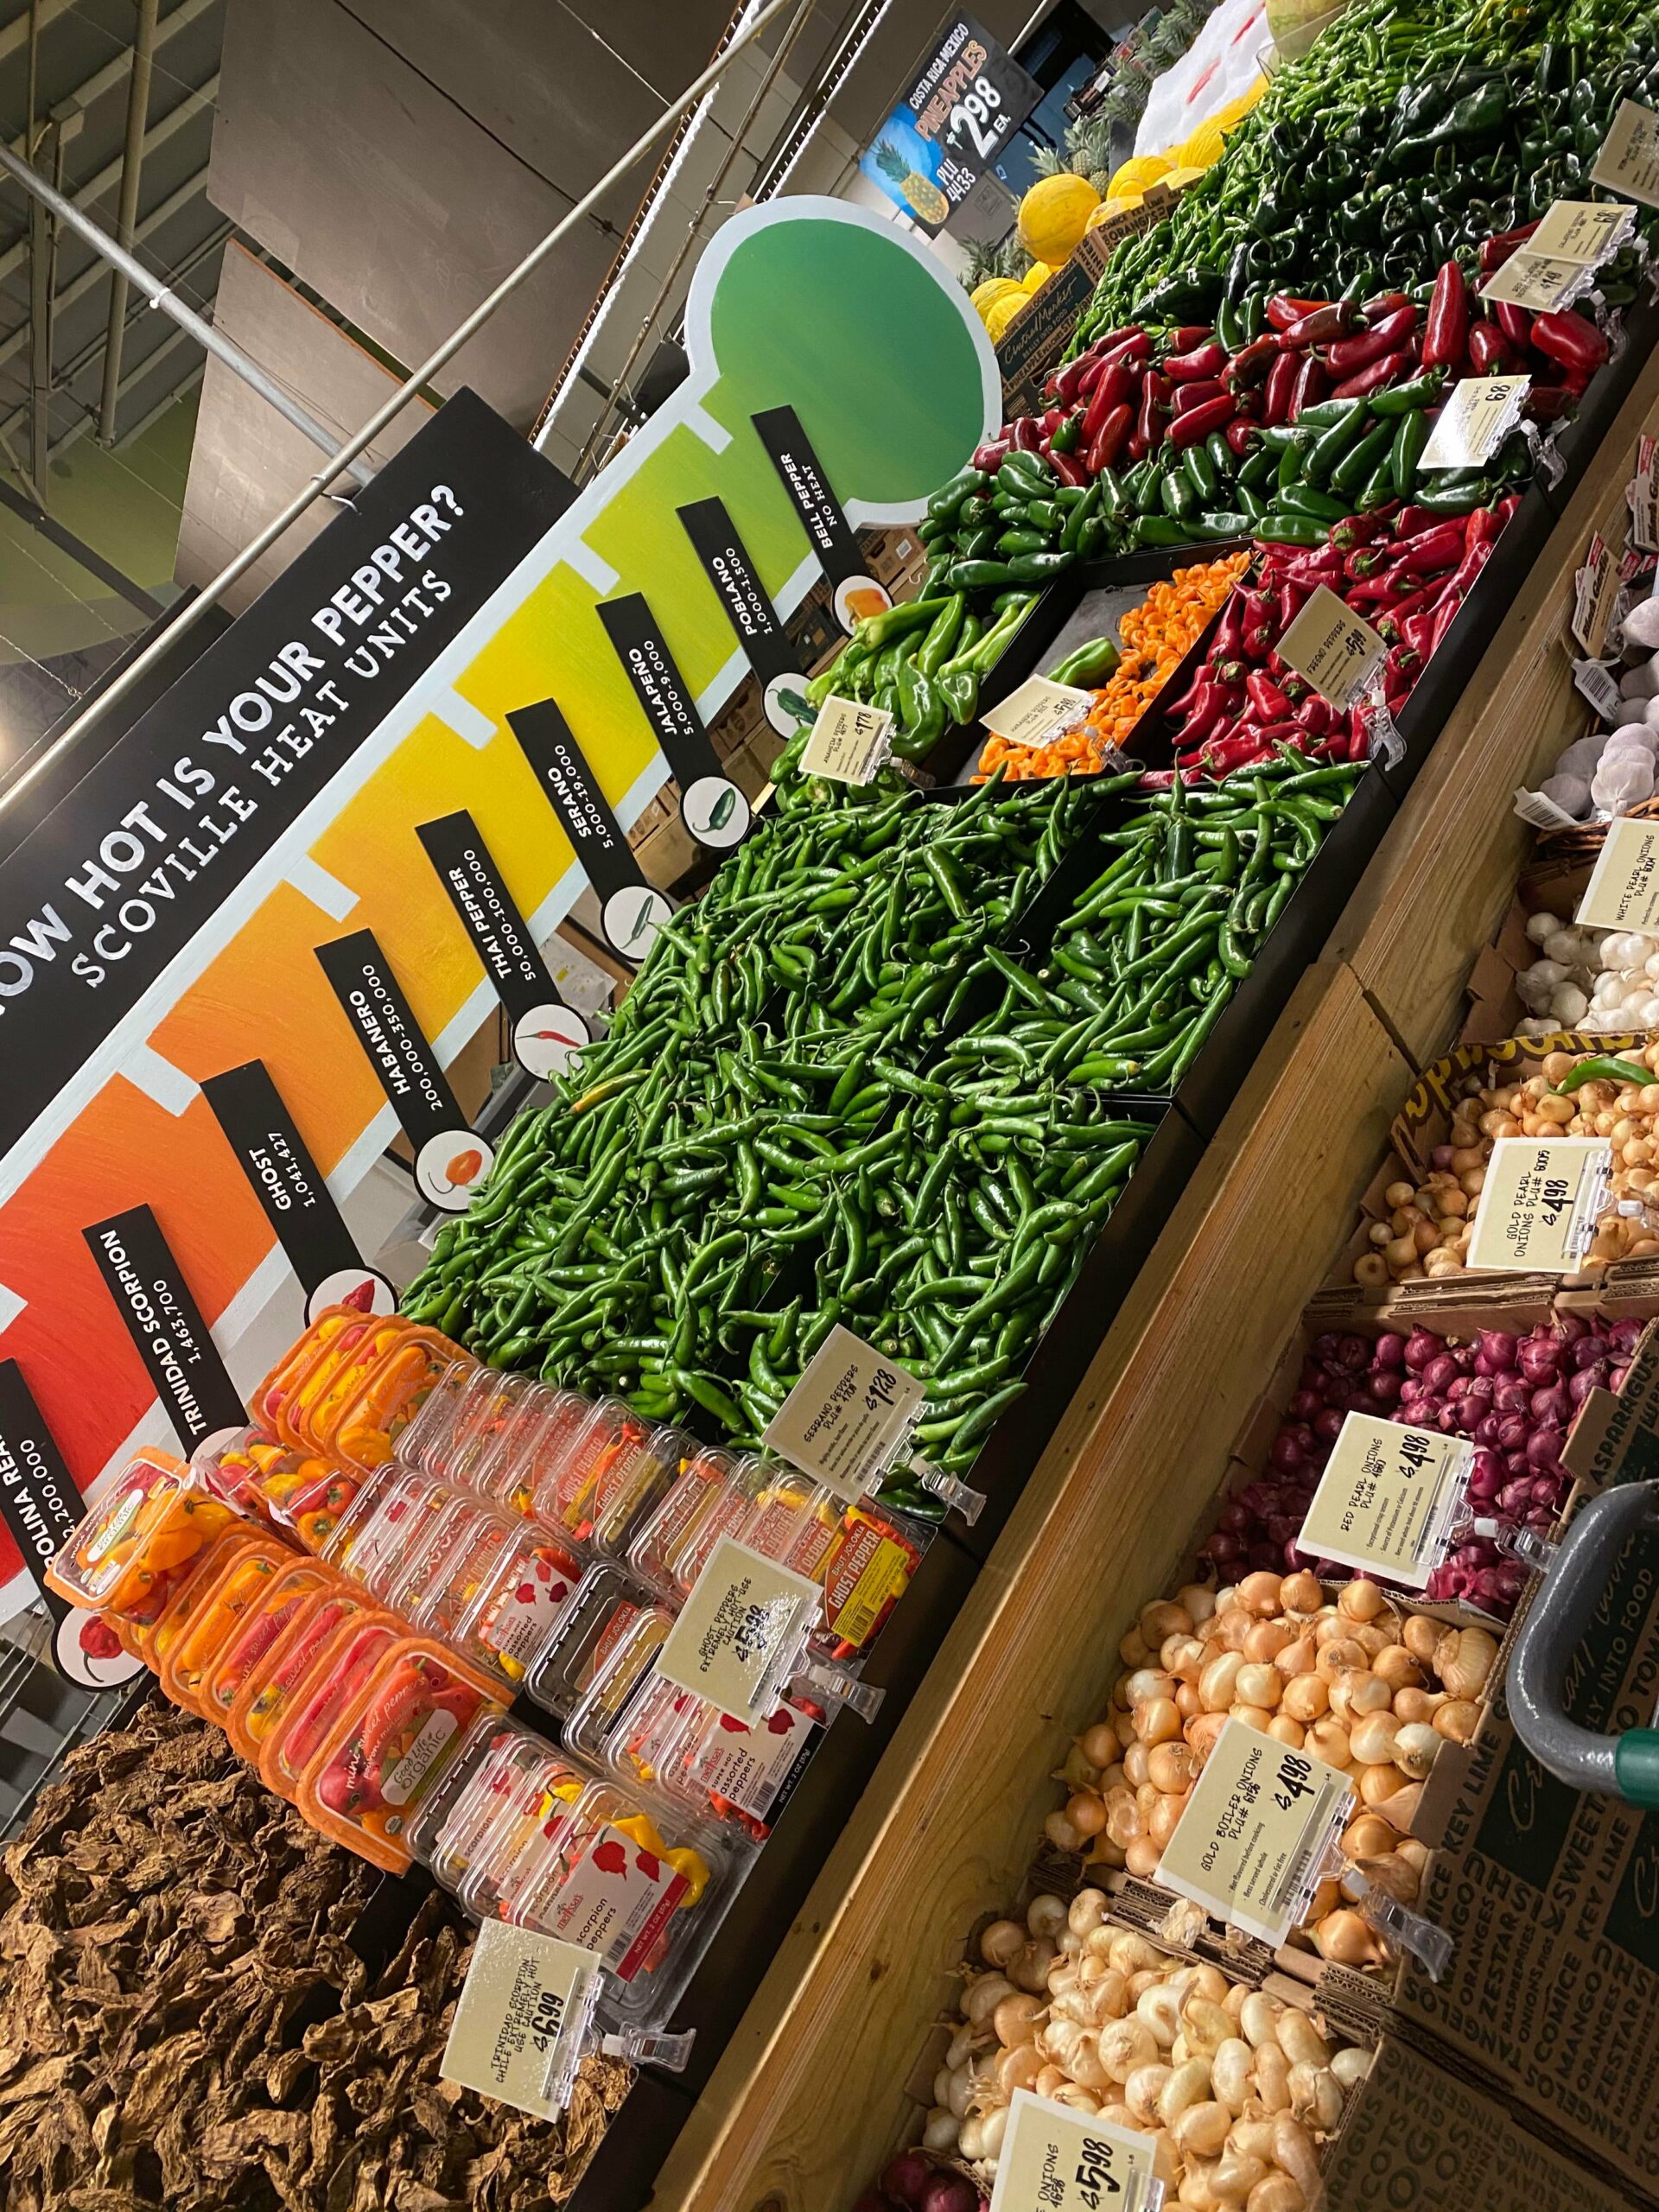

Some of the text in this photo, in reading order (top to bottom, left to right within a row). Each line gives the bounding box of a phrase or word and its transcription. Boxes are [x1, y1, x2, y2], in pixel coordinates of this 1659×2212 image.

[906, 77, 935, 111] COSTA
[911, 38, 991, 142] PINEAPPLES
[933, 156, 961, 186] PLU
[944, 165, 979, 205] 4433
[780, 453, 833, 548] BELL PEPPER
[801, 465, 837, 526] NO HEAT
[712, 556, 757, 635] POBLANO
[725, 547, 772, 633] 1,000-1,500
[628, 648, 677, 734] JALAPEÑO
[644, 640, 693, 734] 5,000-9,000
[0, 485, 463, 1013] OW HOT IS YOUR PEPPER?
[822, 712, 847, 763] ANAHEIM PEPPERS
[71, 569, 450, 987] SCOVILLE HEAT UNITS
[547, 767, 591, 837] SERANO
[554, 745, 613, 848] 5,000-19,000
[1614, 833, 1656, 922] WHITE PEARL ONIONS
[1634, 874, 1649, 898] PLU#
[448, 867, 512, 978] THAI PEPPER
[463, 849, 536, 980] 50,000-100,000
[349, 990, 410, 1094] HABANERO
[362, 964, 442, 1110] 200,000-350,000
[248, 1148, 291, 1210] GHOST
[268, 1133, 315, 1206] 1,041,427
[1506, 1171, 1531, 1239] GOLD PEARL
[1541, 1179, 1570, 1225] $498
[1513, 1212, 1534, 1256] ONIONS
[1525, 1176, 1541, 1207] PLU#
[99, 1230, 207, 1434] TRINIDAD SCORPION
[153, 1280, 200, 1363] 1,463,700
[804, 1363, 858, 1442] SERRANO PEPPERS
[822, 1403, 844, 1430] PLU#
[865, 1368, 896, 1410] $128
[1587, 1350, 1659, 1485] ASPARAGUS
[557, 1435, 606, 1503] GHOST PEPPER
[1340, 1438, 1382, 1531] RED PEARL ONIONS
[1398, 1433, 1433, 1478] $498
[595, 1478, 622, 1510] GHOST
[1359, 1480, 1378, 1510] PLU#
[826, 1569, 858, 1610] GHOST
[846, 1529, 881, 1575] PEPPER
[830, 1523, 866, 1576] BHUT JOLOKIA
[506, 1615, 533, 1655] assorted
[512, 1620, 538, 1660] peppers
[599, 1605, 632, 1656] BHUT JOLOKIA
[697, 1583, 740, 1657] GHOST PEPPERS
[697, 1617, 732, 1673] EXTREMELY
[721, 1604, 747, 1646] CAUTION
[342, 1711, 383, 1791] mini sweet
[391, 1735, 429, 1785] Good Life
[398, 1727, 448, 1793] organic
[709, 1751, 734, 1789] SUPER HOT
[717, 1746, 749, 1795] assorted
[727, 1755, 758, 1802] peppers
[777, 1789, 788, 1802] NET
[793, 1763, 803, 1774] OZ
[1274, 1754, 1312, 1810] $498
[1198, 1745, 1263, 1872] GOLD BOILER ONIONS
[1227, 1781, 1262, 1840] PLU# 6156
[1439, 1727, 1504, 1857] KEY LIME
[573, 1895, 609, 1946] scorpion
[1242, 1884, 1254, 1897] Best
[1257, 1875, 1277, 1906] Cholesterol
[583, 1904, 619, 1953] peppers
[1455, 1894, 1498, 2008] ORANGES
[1529, 1815, 1633, 2065] COMICE KEY LIME
[1475, 1908, 1522, 2024] ZESTAR
[489, 1957, 530, 2070] TRINIDAD SCORPION
[494, 1956, 540, 2083] CHILE EXTREMELY HOT
[512, 1980, 543, 2053] USE CAUTION
[527, 1989, 565, 2056] $699
[1395, 1974, 1531, 2074] TANGELOS
[1552, 1967, 1605, 2080] MANGO
[1589, 1994, 1643, 2107] ZESTAR
[1036, 2141, 1058, 2202] ONIONS
[1076, 2135, 1115, 2212] $598
